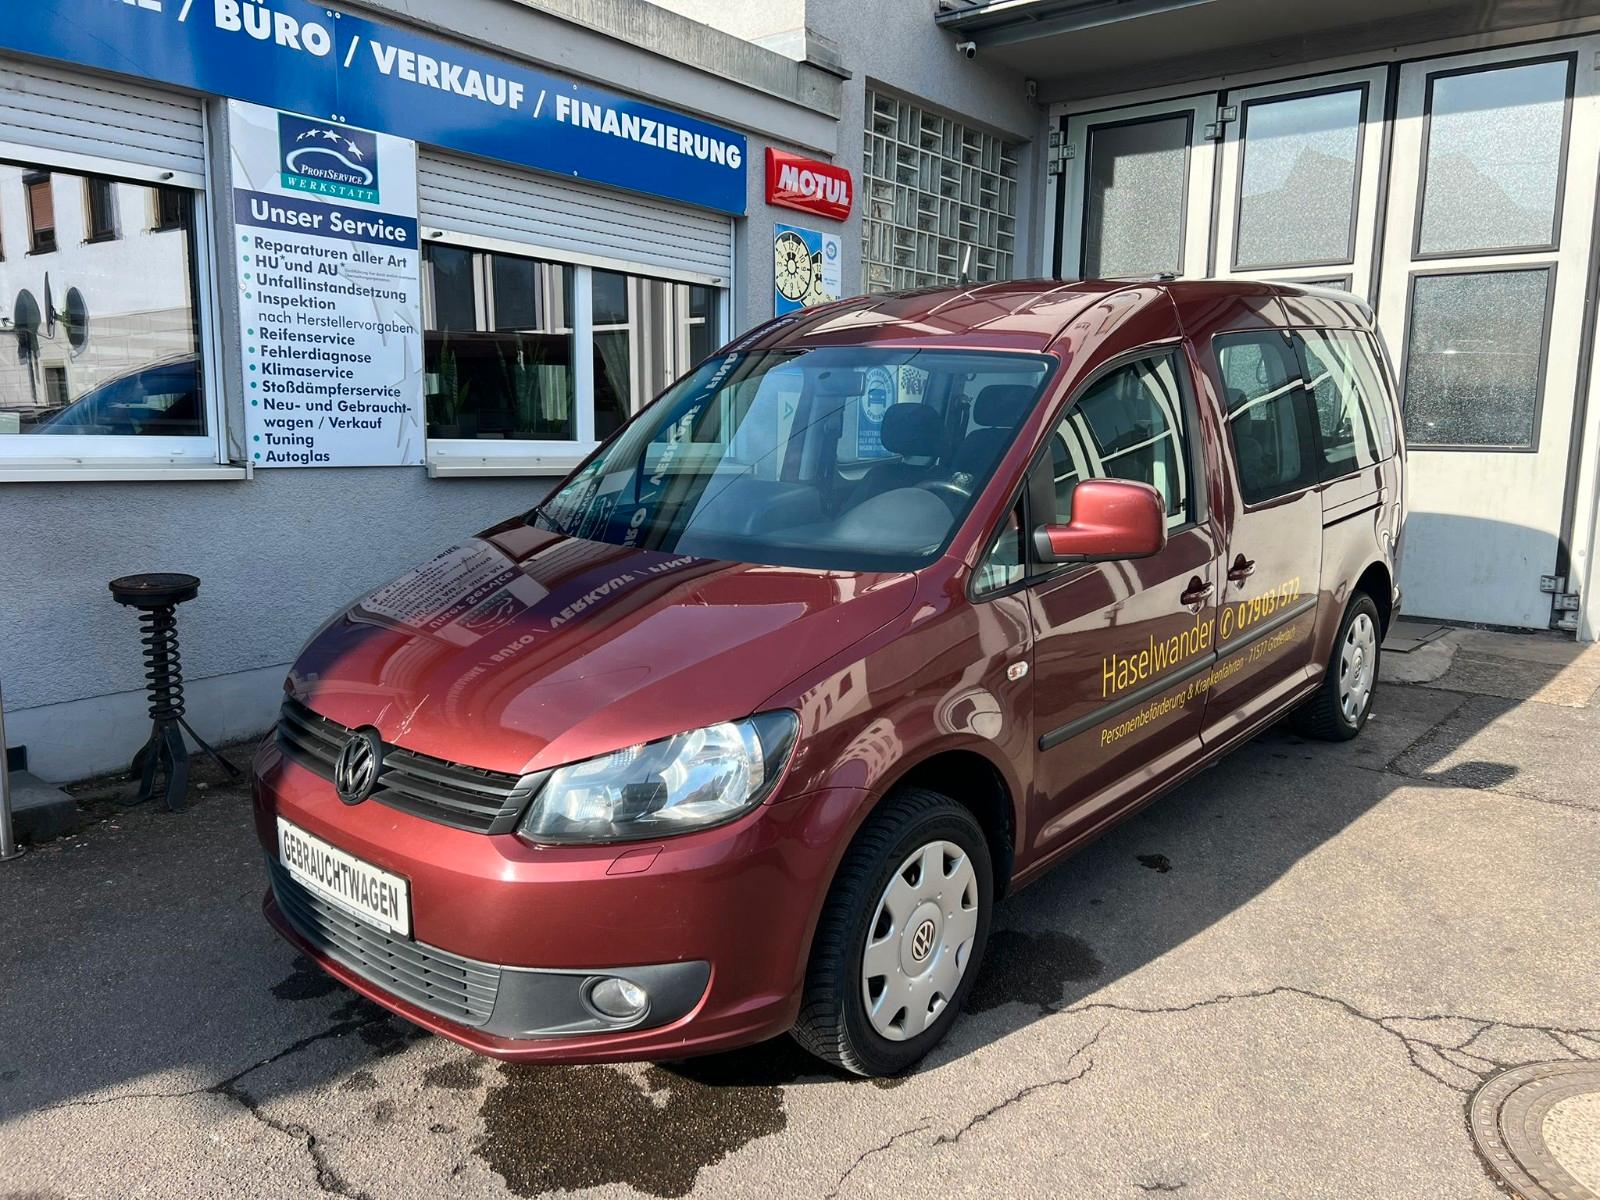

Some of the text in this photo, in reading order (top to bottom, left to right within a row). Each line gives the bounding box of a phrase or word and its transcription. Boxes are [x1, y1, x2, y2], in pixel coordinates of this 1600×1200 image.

[214, 0, 332, 57] BÜRO
[369, 40, 525, 110] VERKAUF
[556, 95, 742, 169] FINANZIERUNG
[288, 177, 374, 200] WERKSTATT
[777, 164, 850, 206] MOTUL
[250, 198, 407, 242] Unser Service
[254, 236, 407, 268] Reparaturen aller Art
[256, 272, 407, 303] Unfallinstandsetzung
[257, 291, 336, 310] Inspektion
[258, 310, 414, 335] nach Herstellervorgaben
[259, 327, 356, 346] Reifenservice
[260, 345, 372, 365] Fehlerdiagnose
[261, 362, 354, 379] Klimaservice
[262, 380, 401, 398] Stoßdämpferservice
[263, 398, 412, 414] Neu- und Gebraucht-
[264, 417, 314, 431] wagen
[328, 416, 383, 429] Verkauf
[265, 433, 314, 448] Tuning
[266, 450, 330, 465] Autoglas
[1102, 614, 1215, 698] Haselwander
[1100, 690, 1186, 748] Personenbeförderung
[1194, 657, 1244, 697] Krankenfahrten
[283, 830, 399, 921] GEBRAUCHTWAGEN
